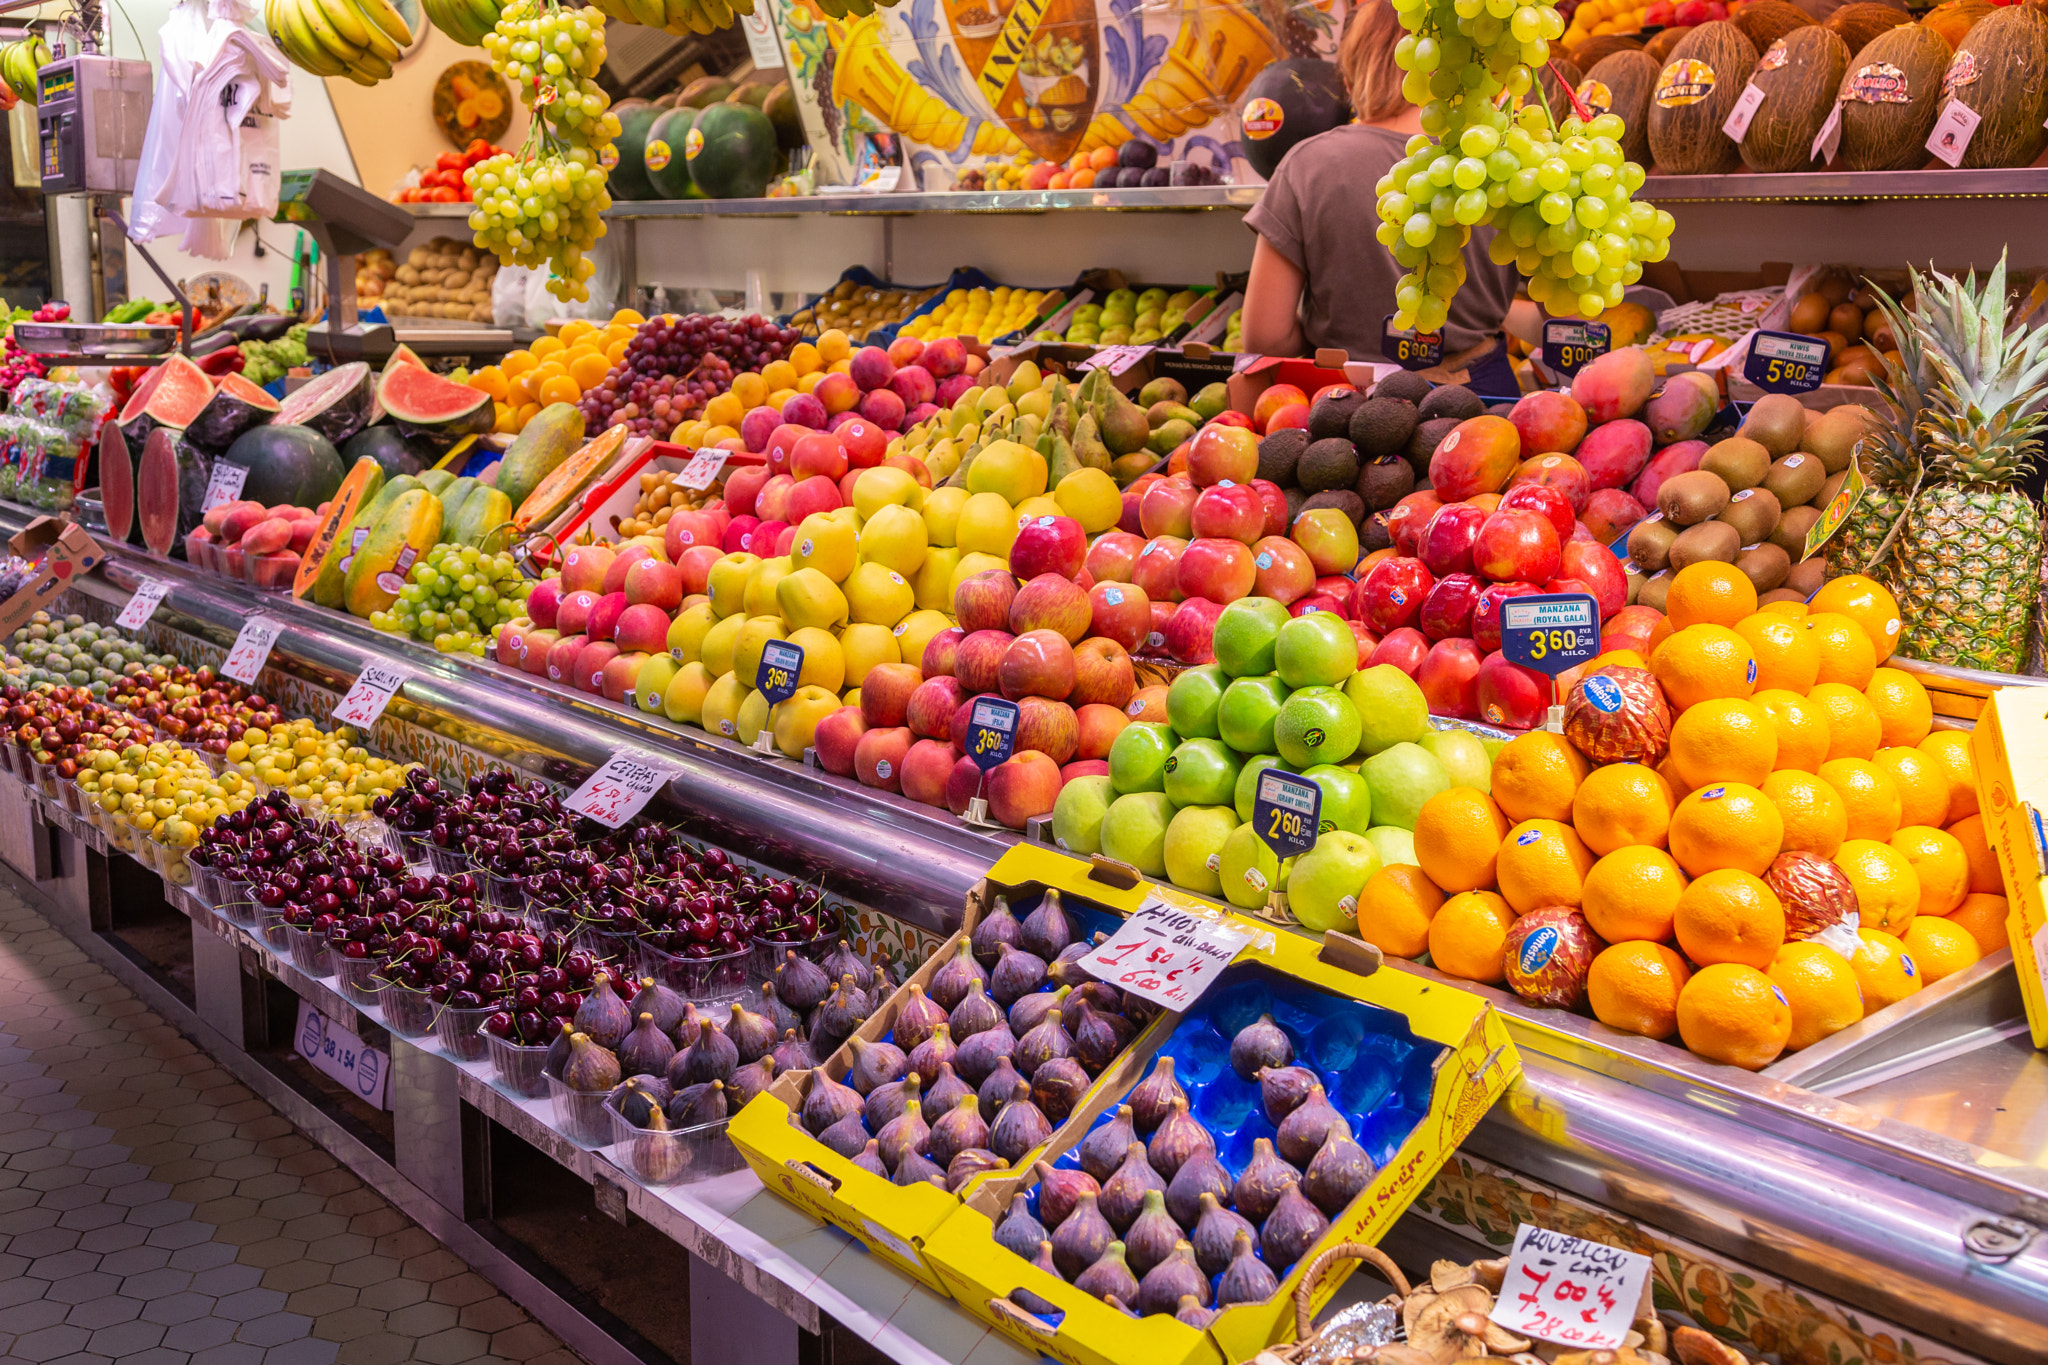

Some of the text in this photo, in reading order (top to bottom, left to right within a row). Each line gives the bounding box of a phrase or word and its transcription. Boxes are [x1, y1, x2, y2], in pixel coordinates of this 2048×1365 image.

[1856, 75, 1898, 91] BOLLO
[1790, 343, 1810, 352] KIWIS
[1766, 359, 1806, 383] 5'80
[1790, 380, 1812, 388] KILO.
[1539, 604, 1580, 613] MANZANA
[1534, 616, 1562, 625] (ROYAL
[1564, 614, 1587, 623] GALA)
[1529, 628, 1577, 660] 3'60
[1586, 677, 1620, 711] Fontestad
[1282, 784, 1309, 799] MANZANA
[1294, 798, 1313, 812] SMITH)
[1267, 808, 1301, 839] 2'60
[1288, 836, 1307, 847] KILO.
[1136, 903, 1202, 934] HIGOS
[1521, 927, 1556, 973] Fontestad
[324, 1036, 336, 1058] 38
[344, 1049, 356, 1071] 54
[1355, 1205, 1377, 1236] del
[1376, 1150, 1427, 1210] Segre
